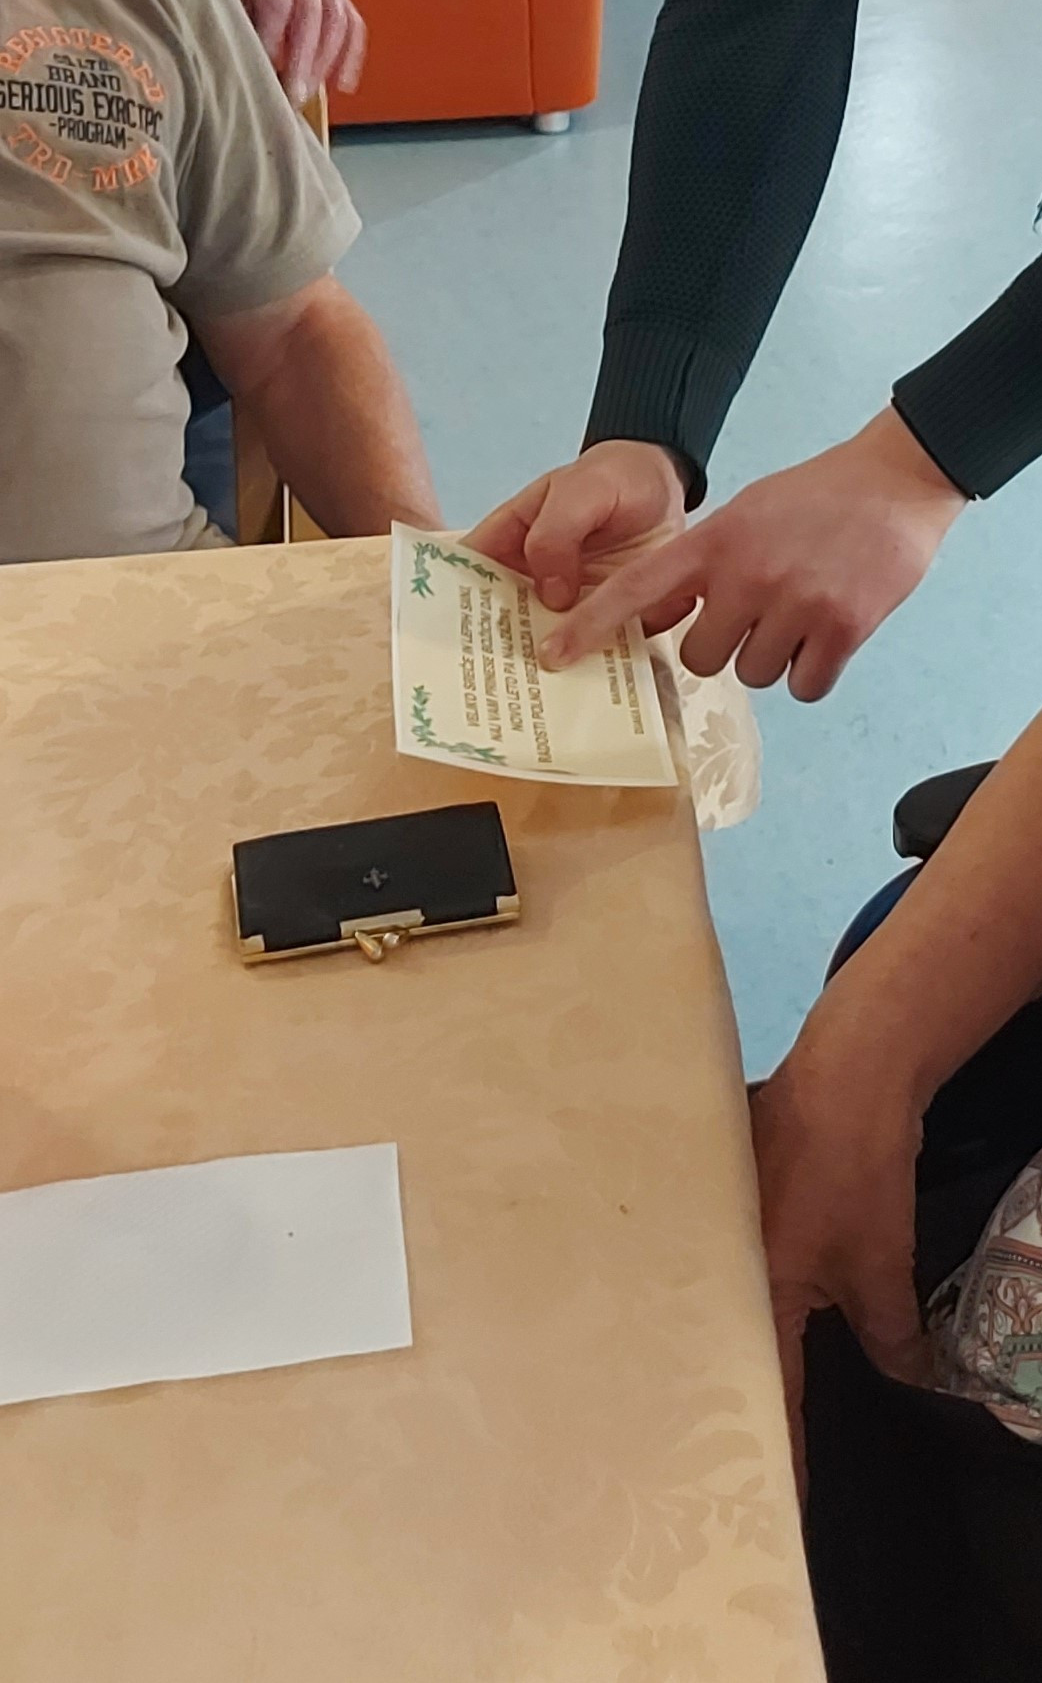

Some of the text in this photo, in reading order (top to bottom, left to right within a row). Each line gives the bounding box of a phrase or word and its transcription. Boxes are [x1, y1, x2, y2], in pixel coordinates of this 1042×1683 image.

[46, 65, 121, 92] BRAND
[461, 645, 473, 655] IN
[503, 663, 516, 675] PA
[505, 676, 520, 701] LETO
[486, 698, 501, 720] VAM
[528, 687, 544, 720] POLNO
[507, 702, 524, 732] NOVO
[533, 721, 552, 763] RADOSTI
